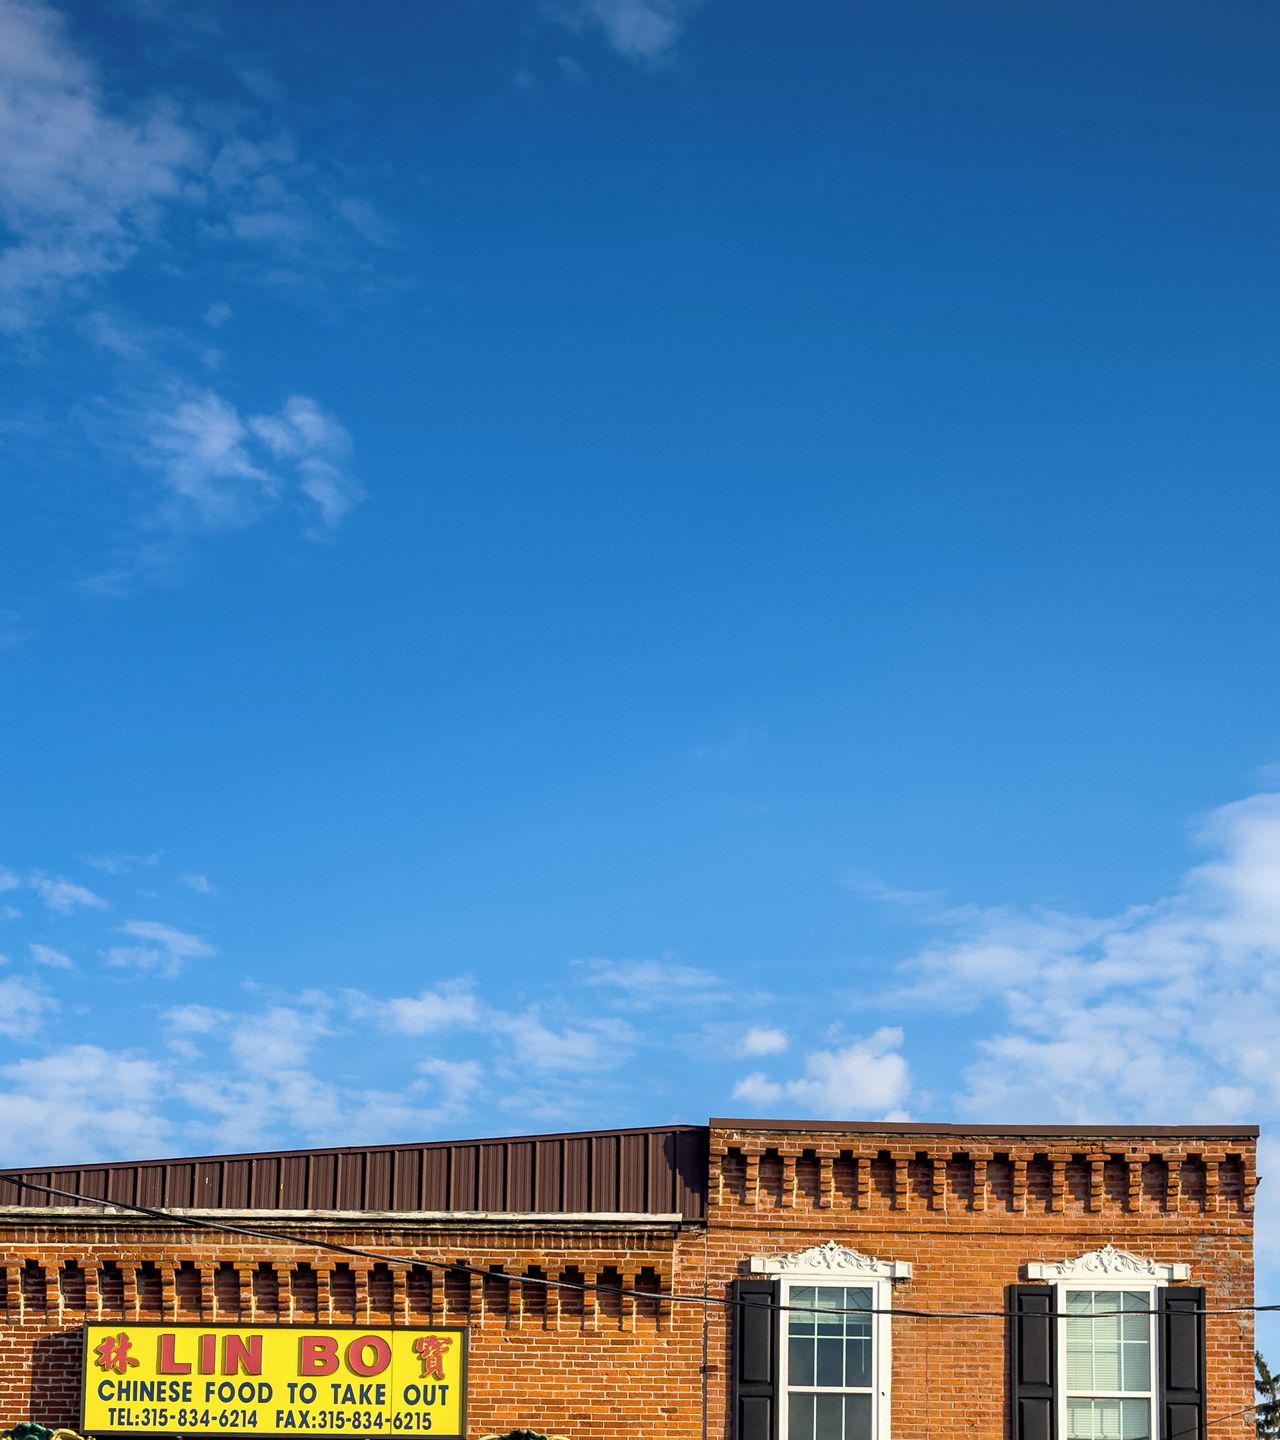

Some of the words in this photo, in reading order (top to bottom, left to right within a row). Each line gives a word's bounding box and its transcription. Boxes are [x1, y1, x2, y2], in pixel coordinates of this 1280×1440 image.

[157, 1334, 263, 1376] LIN
[298, 1335, 392, 1377] BO
[97, 1380, 192, 1403] CHINESE
[205, 1381, 273, 1403] FOOD
[287, 1382, 317, 1404] TO
[331, 1383, 386, 1405] TAKE
[403, 1384, 449, 1406] OUT
[108, 1408, 258, 1428] TEL:315-834-6214
[275, 1410, 432, 1430] FAX:315-834-6215
